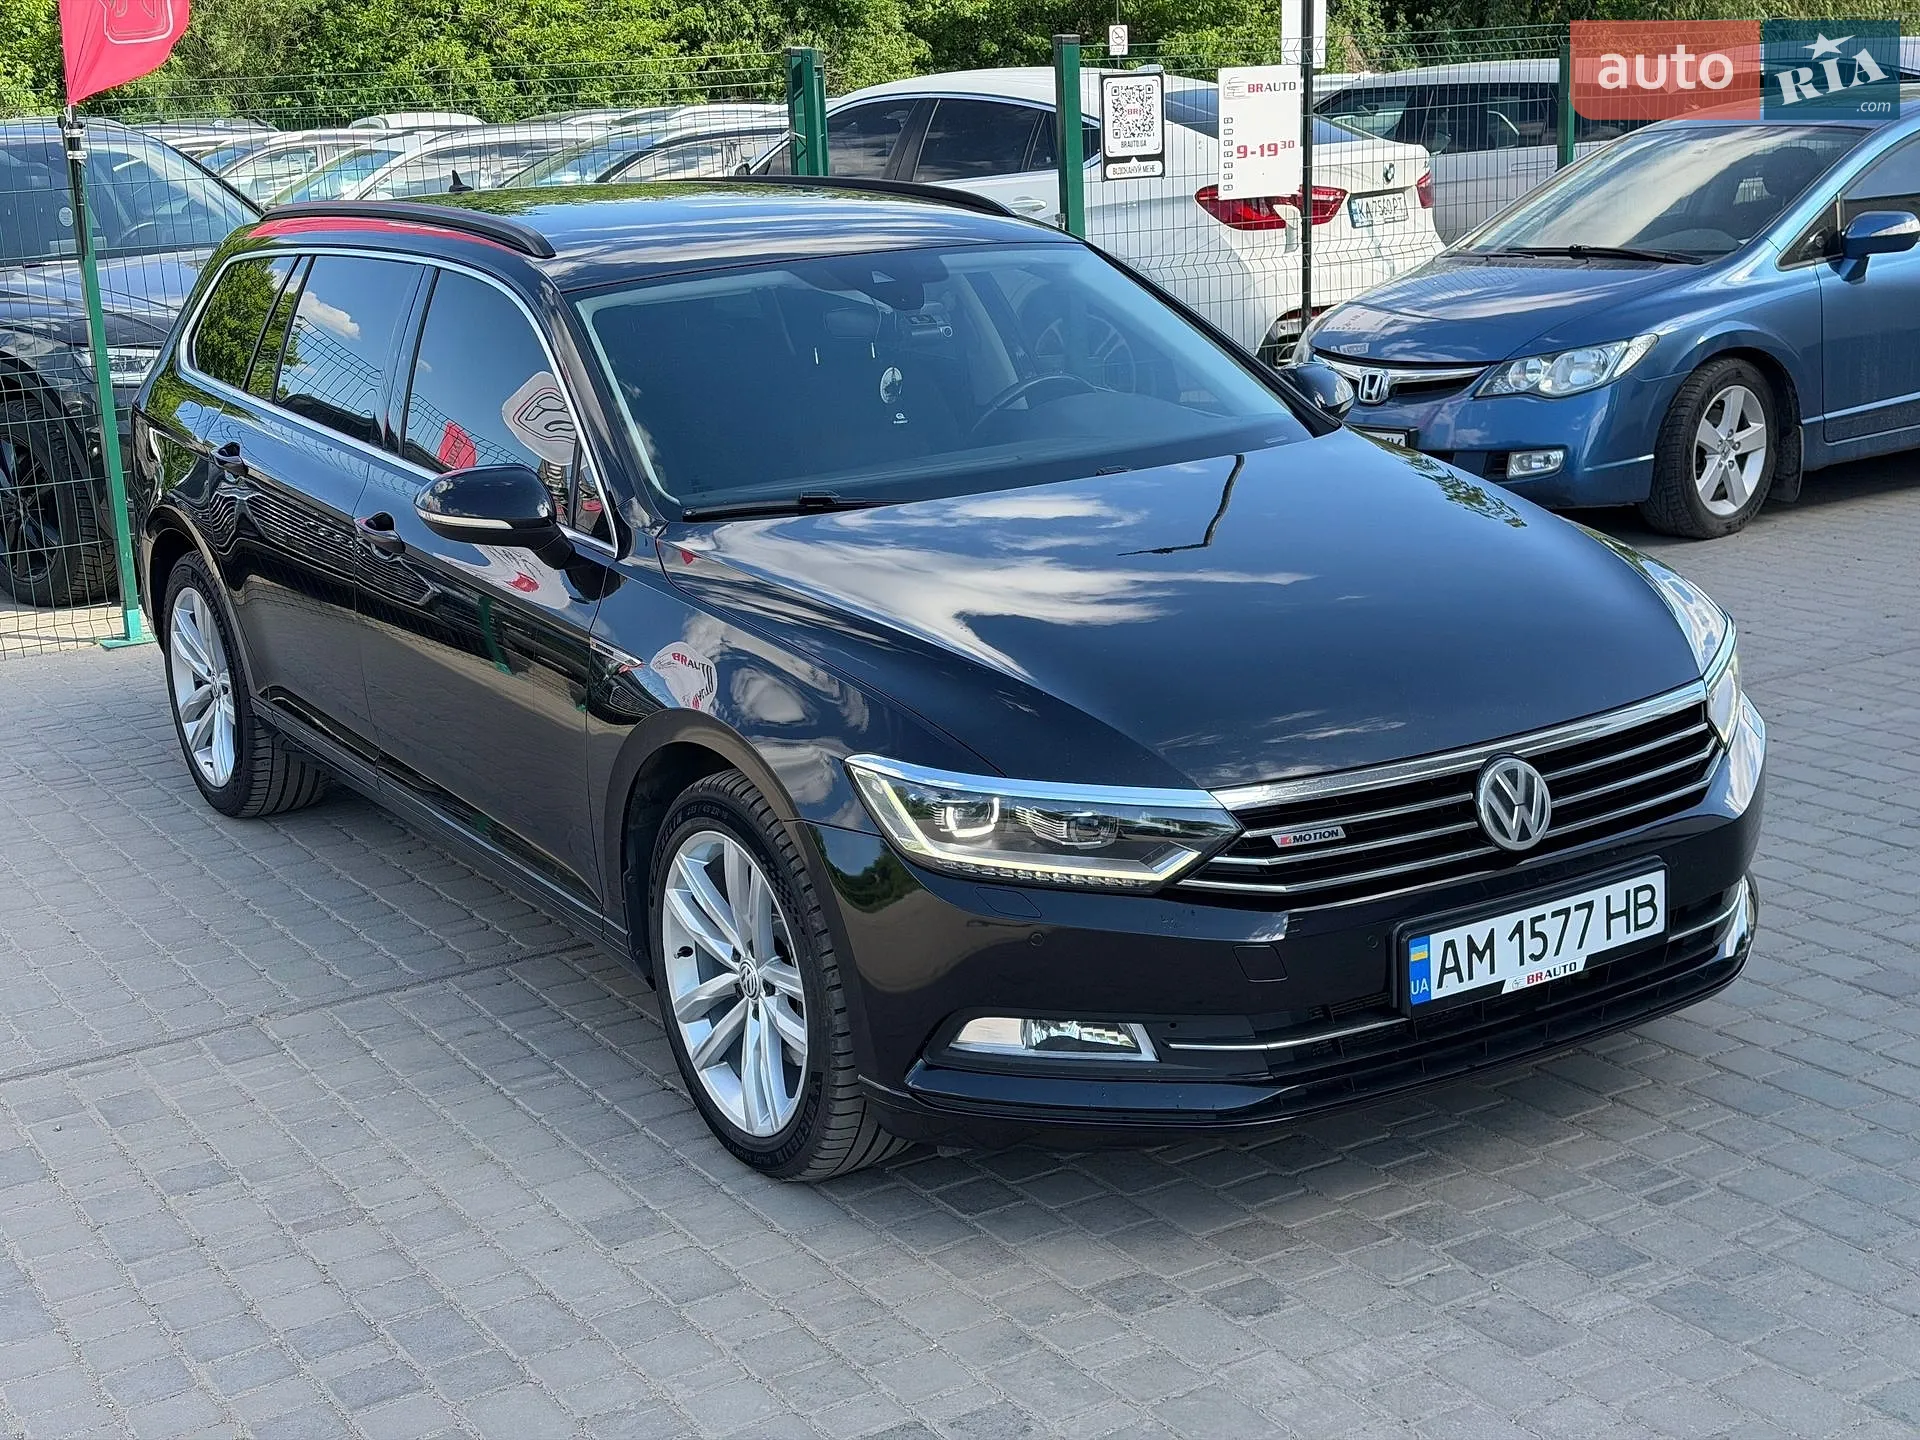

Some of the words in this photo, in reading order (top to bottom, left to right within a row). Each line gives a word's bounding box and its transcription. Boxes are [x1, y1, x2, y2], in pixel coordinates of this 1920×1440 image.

[1247, 81, 1297, 93] BRAUTO
[1436, 927, 1496, 990] AM
[1507, 900, 1595, 966] 1577
[1605, 884, 1658, 941] HB
[1526, 961, 1577, 985] BRAUTO
[1410, 978, 1430, 995] UA
